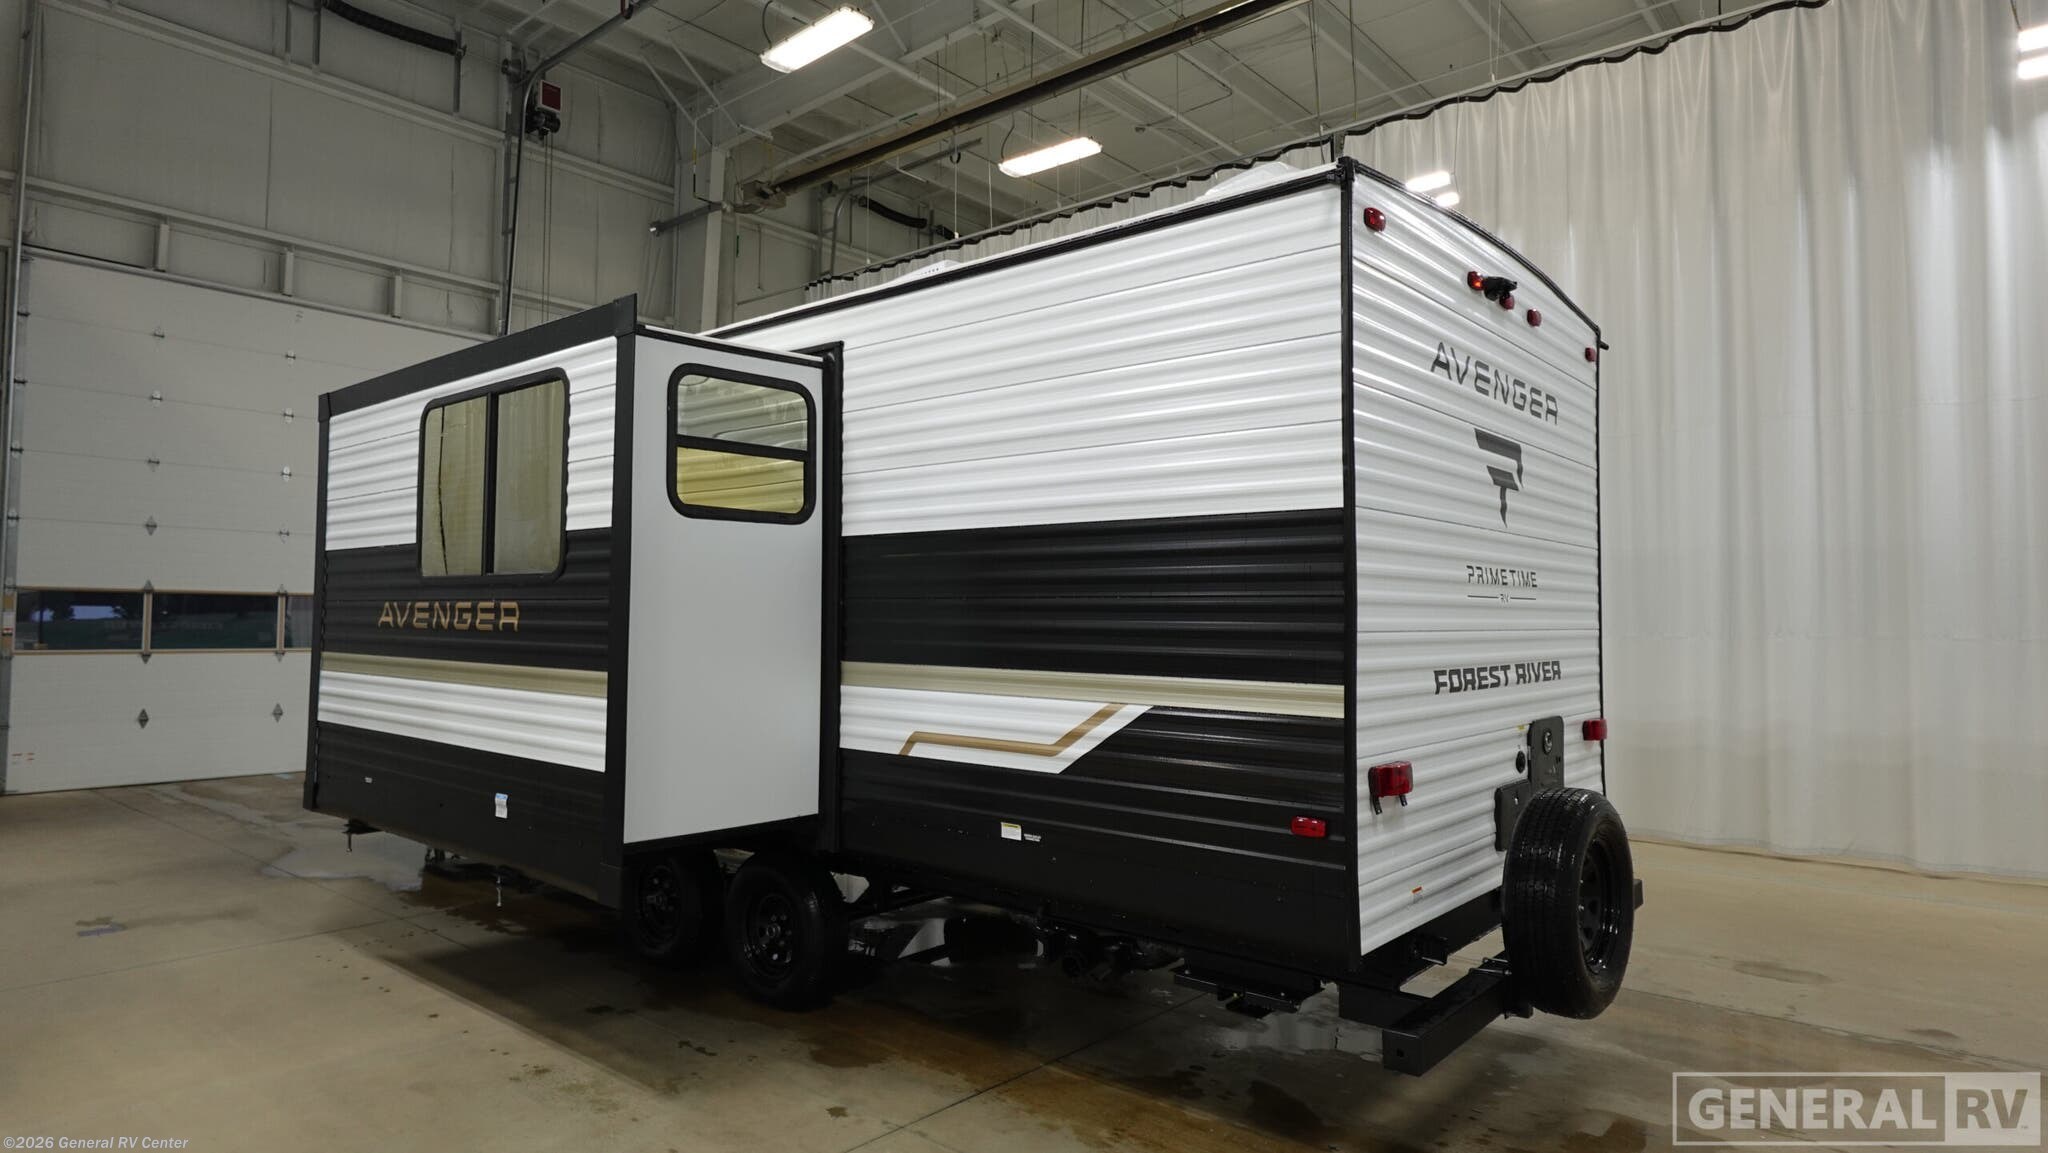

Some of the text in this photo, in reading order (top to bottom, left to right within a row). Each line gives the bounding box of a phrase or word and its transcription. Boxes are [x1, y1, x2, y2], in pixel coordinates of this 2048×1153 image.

[1430, 341, 1559, 425] AVENGER
[377, 600, 521, 632] AVENGER
[1434, 660, 1561, 695] FOREST RIVER
